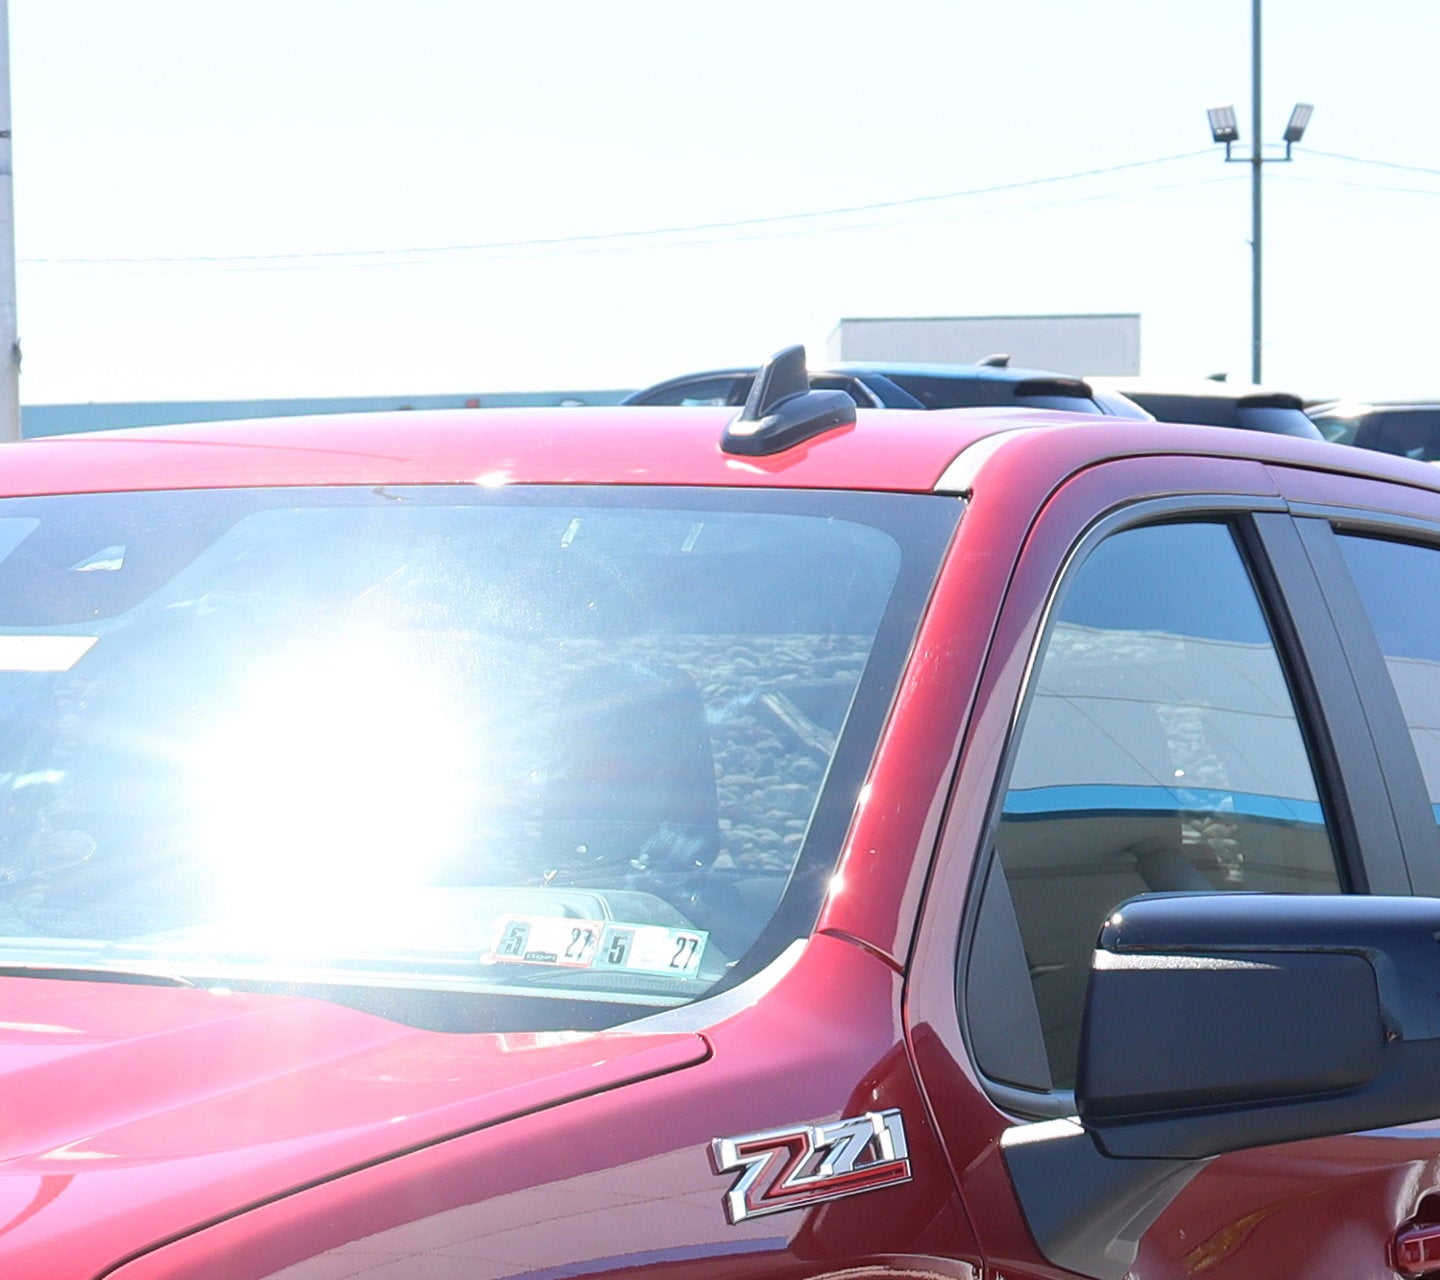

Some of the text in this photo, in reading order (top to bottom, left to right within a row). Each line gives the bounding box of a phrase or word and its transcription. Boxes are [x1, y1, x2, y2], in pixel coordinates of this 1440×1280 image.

[607, 936, 699, 969] 5 27
[706, 1108, 913, 1225] Z71
